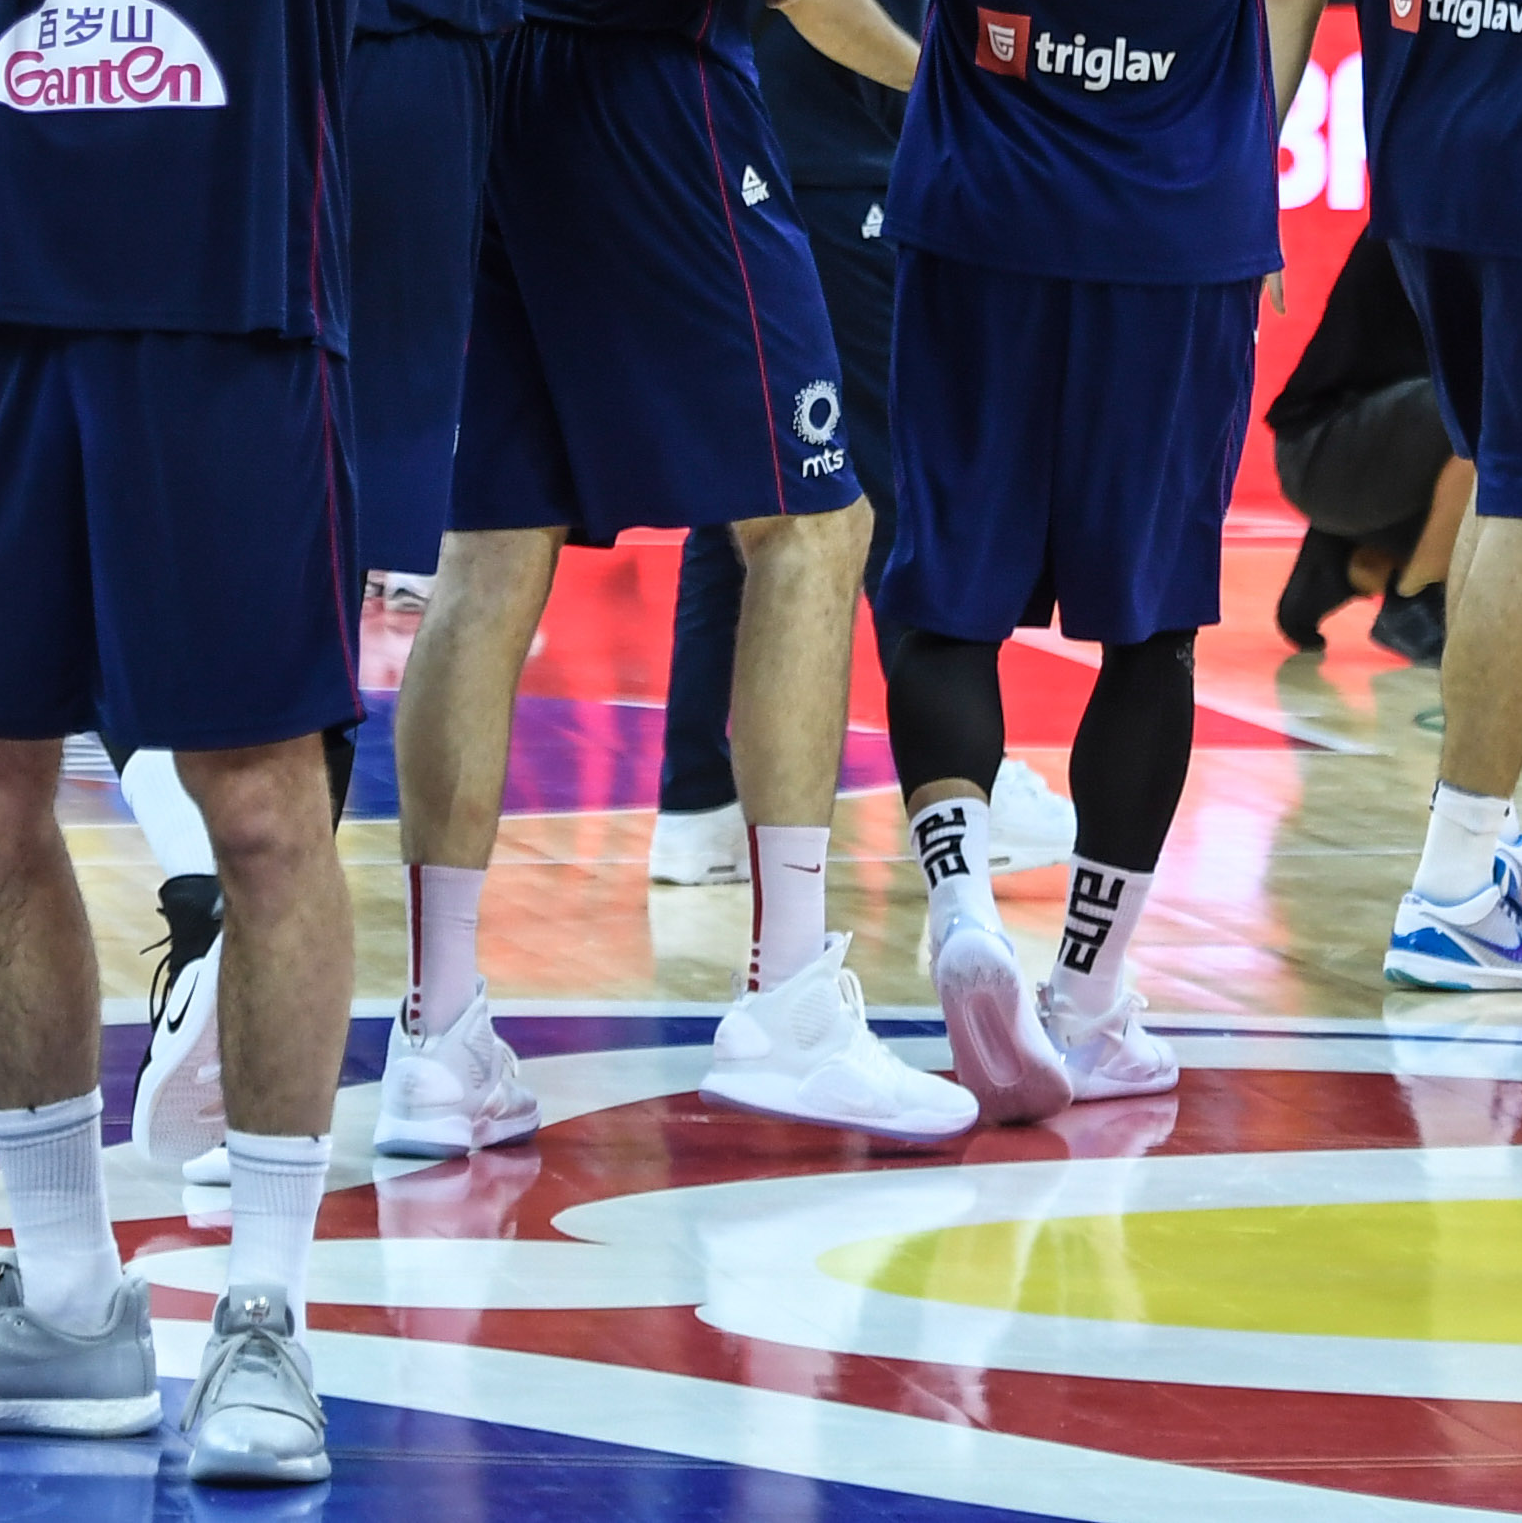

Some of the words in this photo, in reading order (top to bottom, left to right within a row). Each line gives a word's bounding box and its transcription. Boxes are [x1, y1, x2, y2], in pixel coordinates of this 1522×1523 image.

[38, 5, 154, 50] 百岁山
[1034, 32, 1176, 92] triglav
[802, 448, 845, 478] mts
